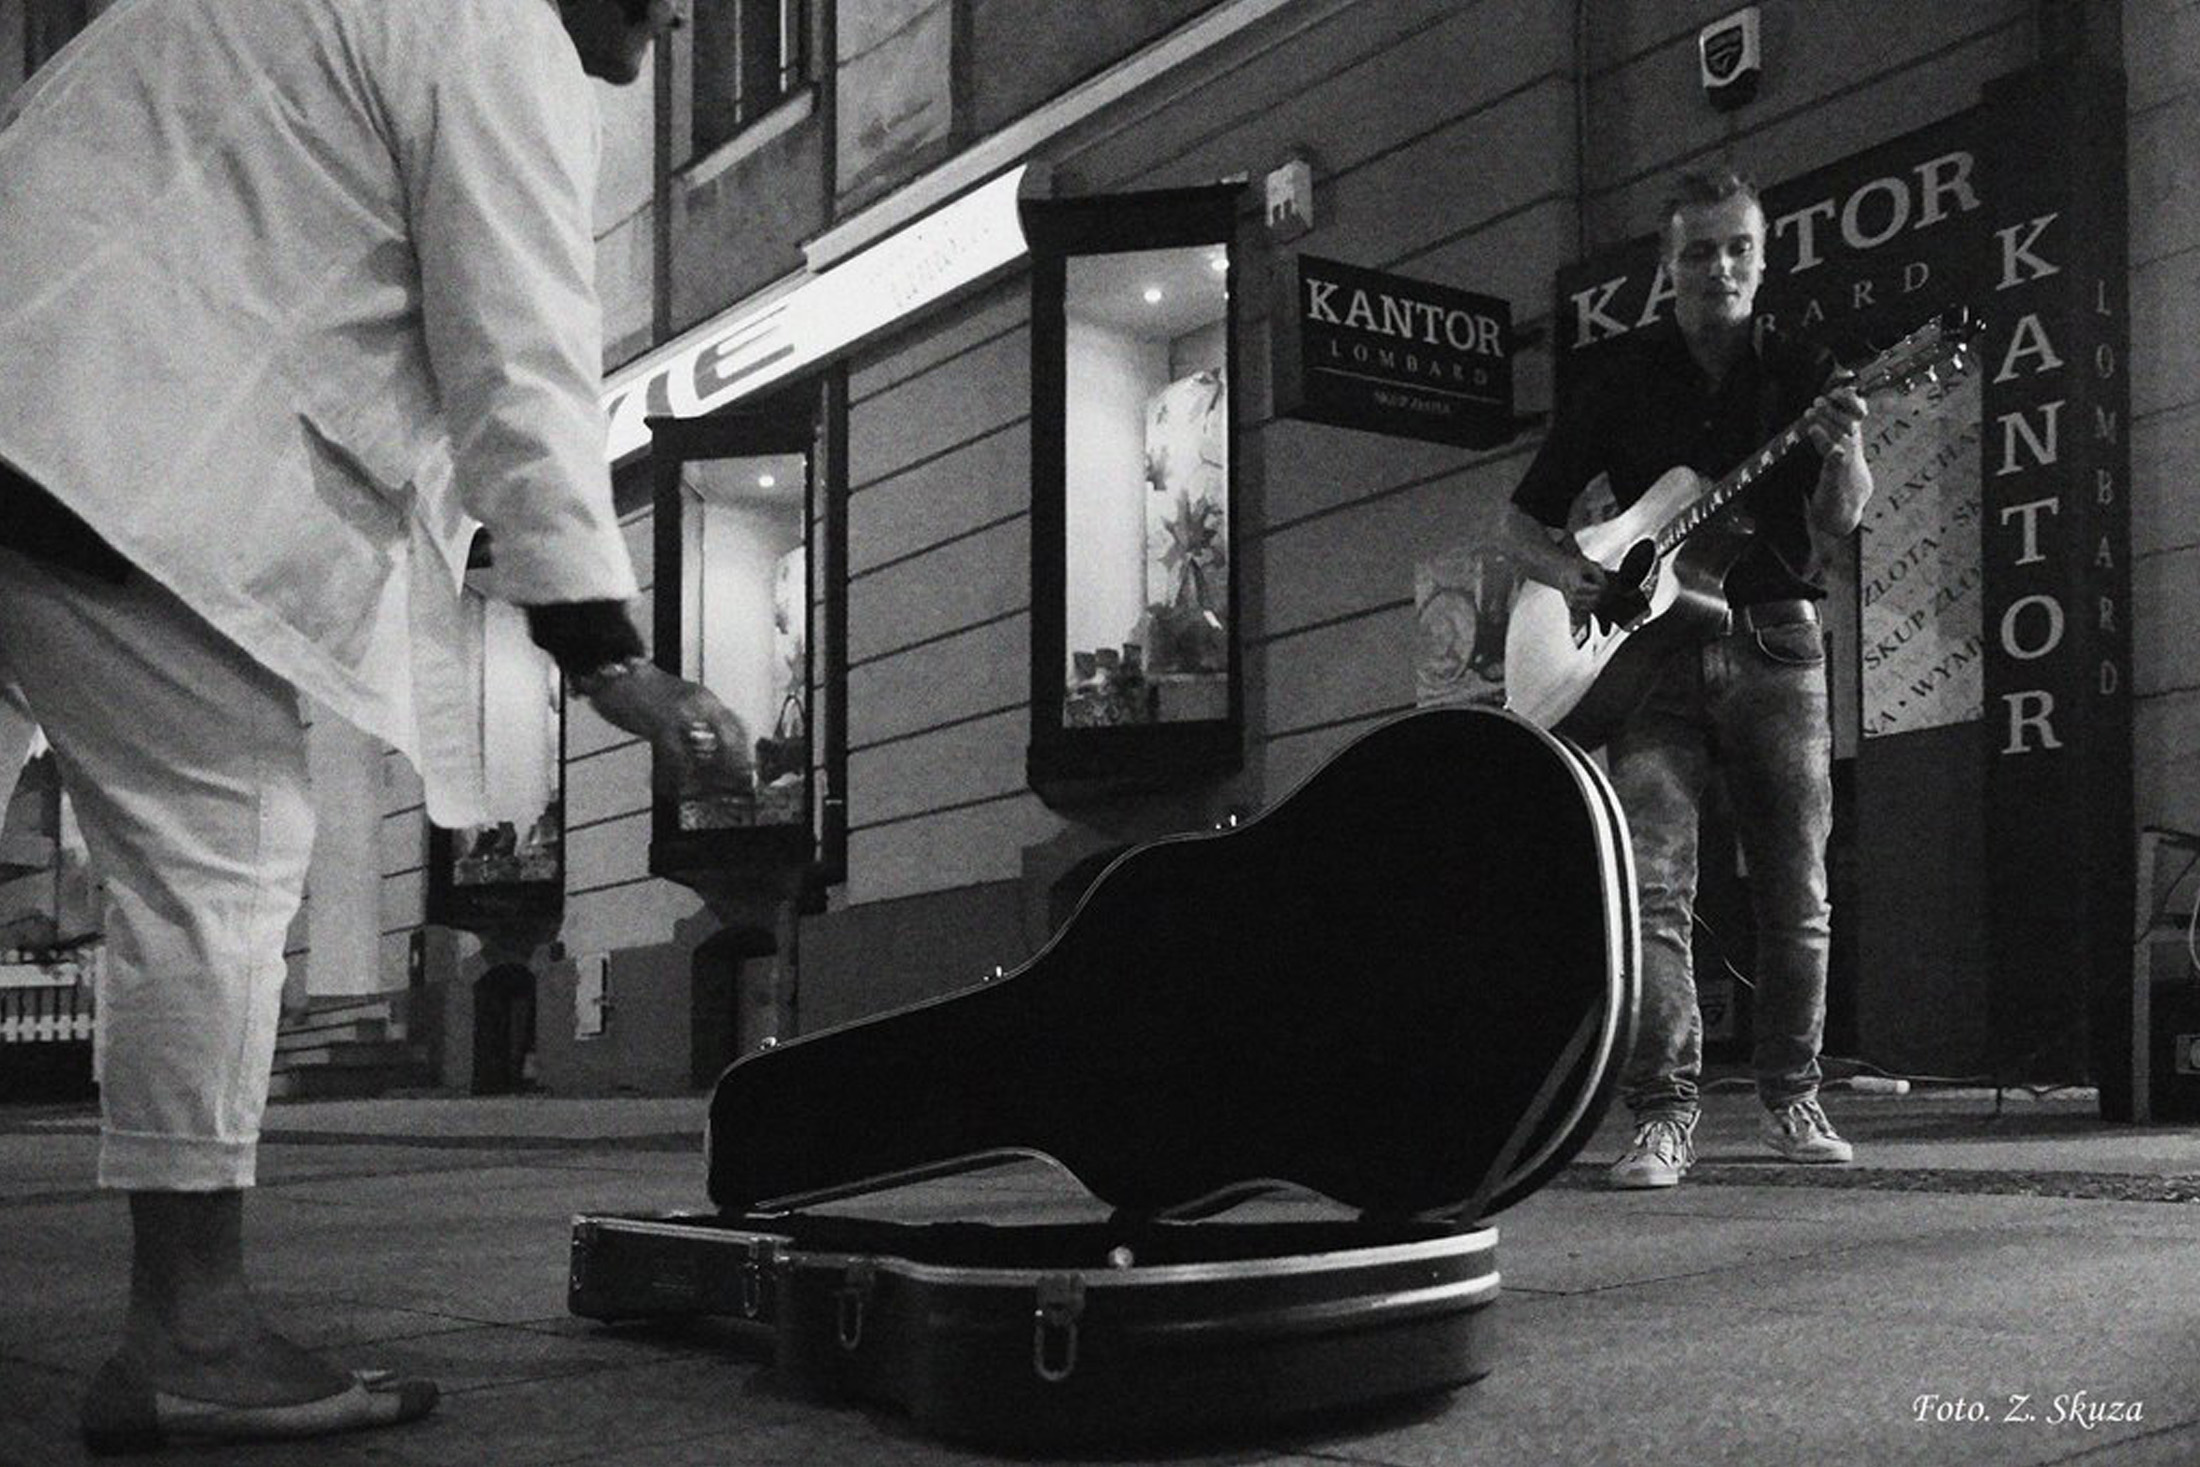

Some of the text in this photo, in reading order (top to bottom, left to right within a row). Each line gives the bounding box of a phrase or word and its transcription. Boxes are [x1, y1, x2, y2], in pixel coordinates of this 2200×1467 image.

[1571, 151, 1980, 349] KATOR
[1306, 278, 1504, 358] KANTOR
[1754, 261, 1930, 333] BARD
[1331, 339, 1488, 386] LOMBARD
[1993, 212, 2065, 754] KANTOR
[2095, 279, 2118, 695] LOMBARD
[1864, 610, 1926, 671] SKUP
